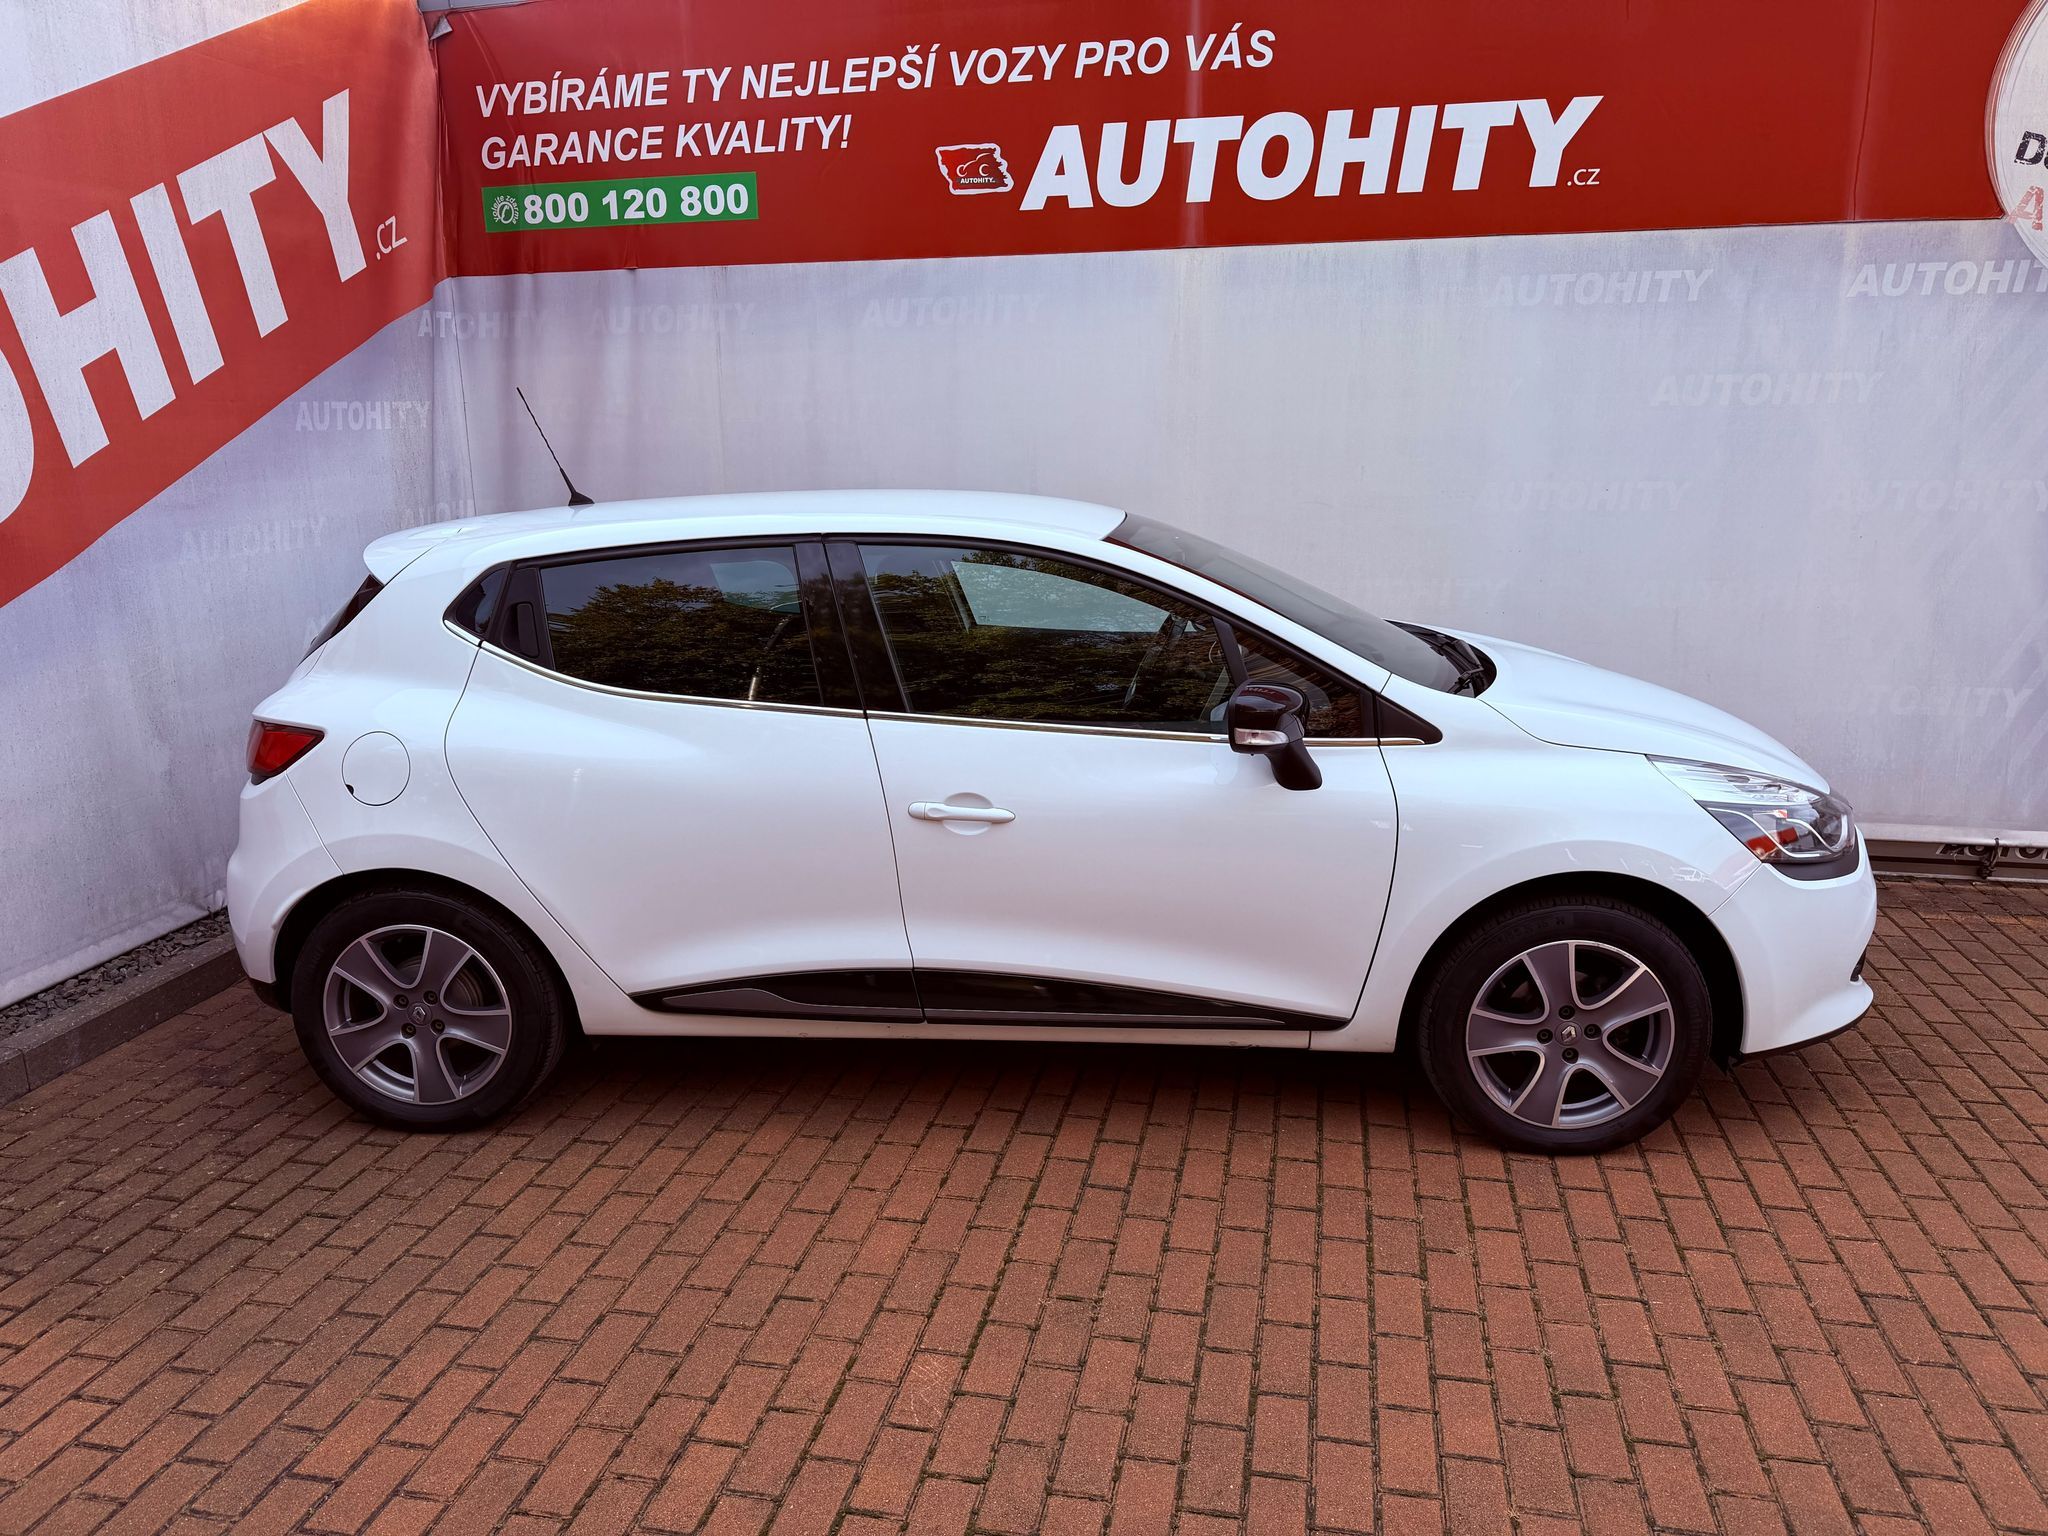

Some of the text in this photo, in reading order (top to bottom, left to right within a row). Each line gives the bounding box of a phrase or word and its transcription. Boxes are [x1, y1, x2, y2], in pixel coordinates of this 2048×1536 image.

[475, 22, 1277, 118] VYBÍRÁME TY NEJLEPŠÍ VOZY PRO VÁS
[480, 114, 853, 170] GARANCE KVALITY!
[2013, 131, 2048, 170] D
[523, 183, 749, 225] 800 120 800
[1487, 270, 1714, 306] AUTOHITY
[1648, 371, 1884, 408] AUTOHITY
[295, 400, 431, 432] AUTOHITY
